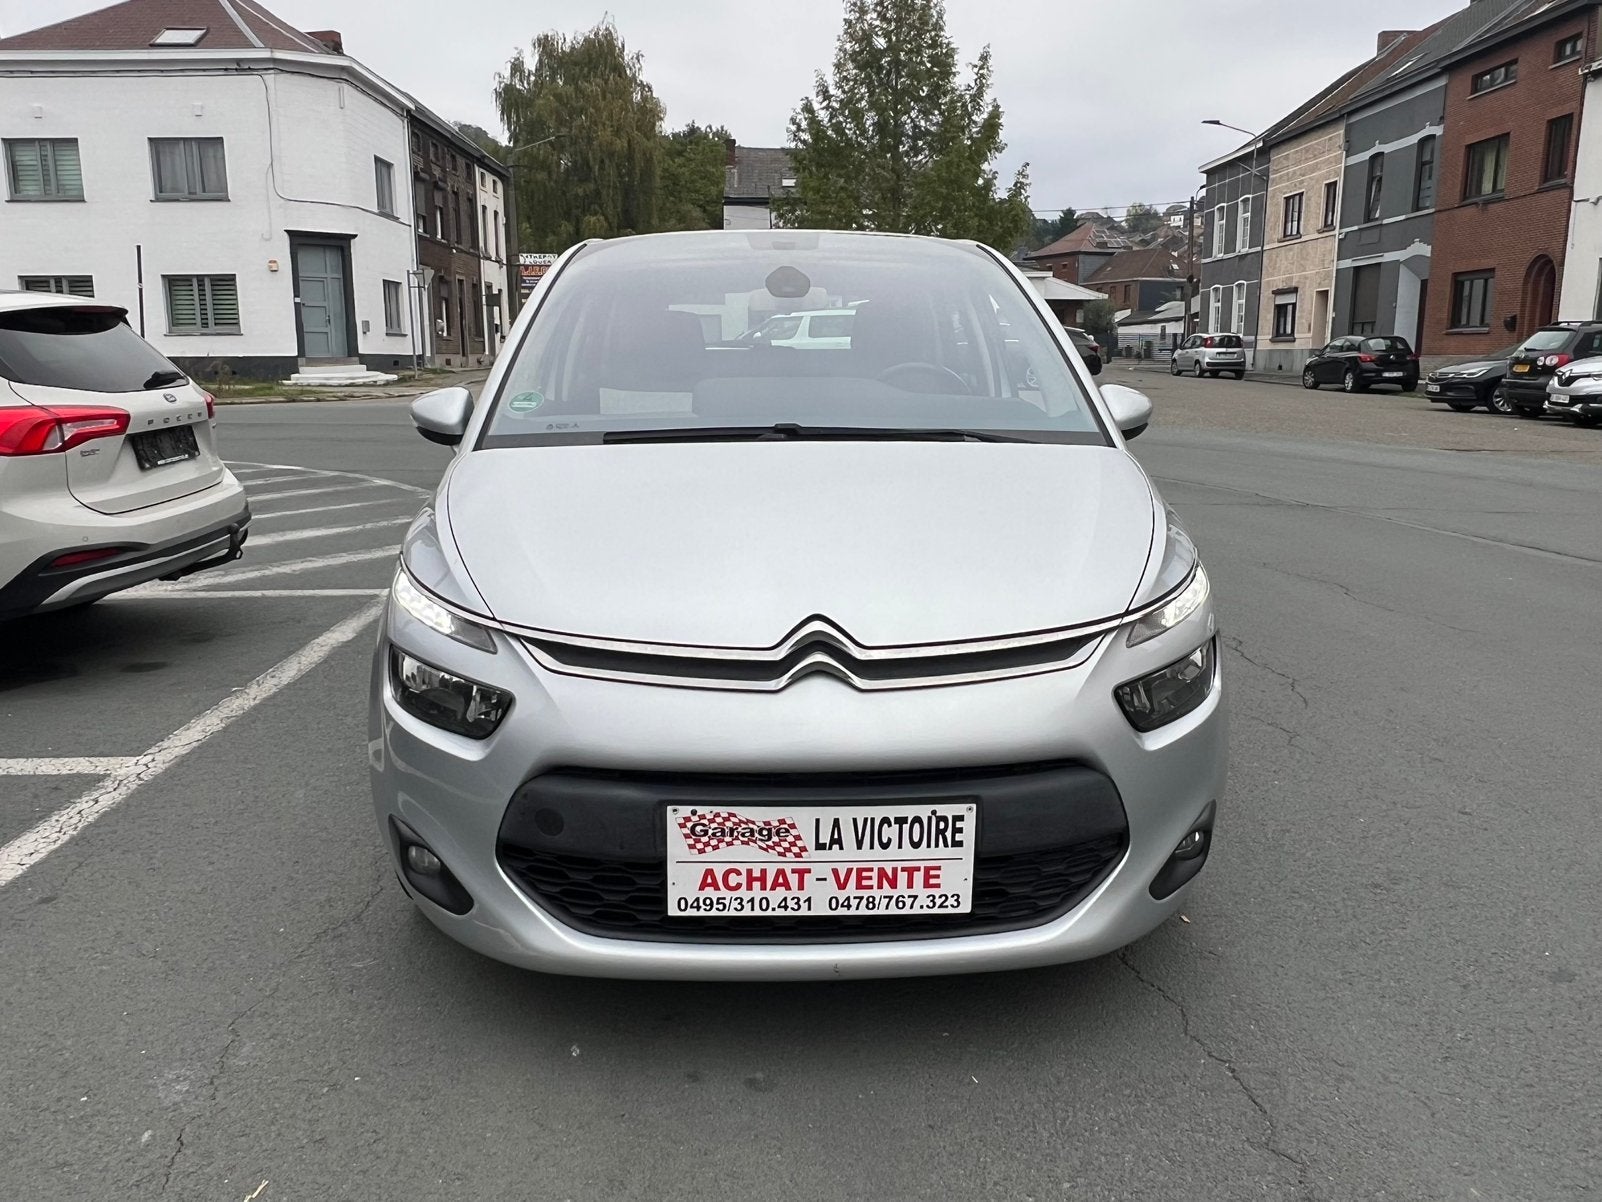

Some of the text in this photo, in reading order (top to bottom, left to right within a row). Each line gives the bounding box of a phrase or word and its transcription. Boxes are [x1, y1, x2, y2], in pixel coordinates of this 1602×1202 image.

[689, 822, 791, 842] Garage
[814, 814, 965, 851] LA VICTOIRE
[677, 893, 961, 912] 0495/310.431 0478/767.323
